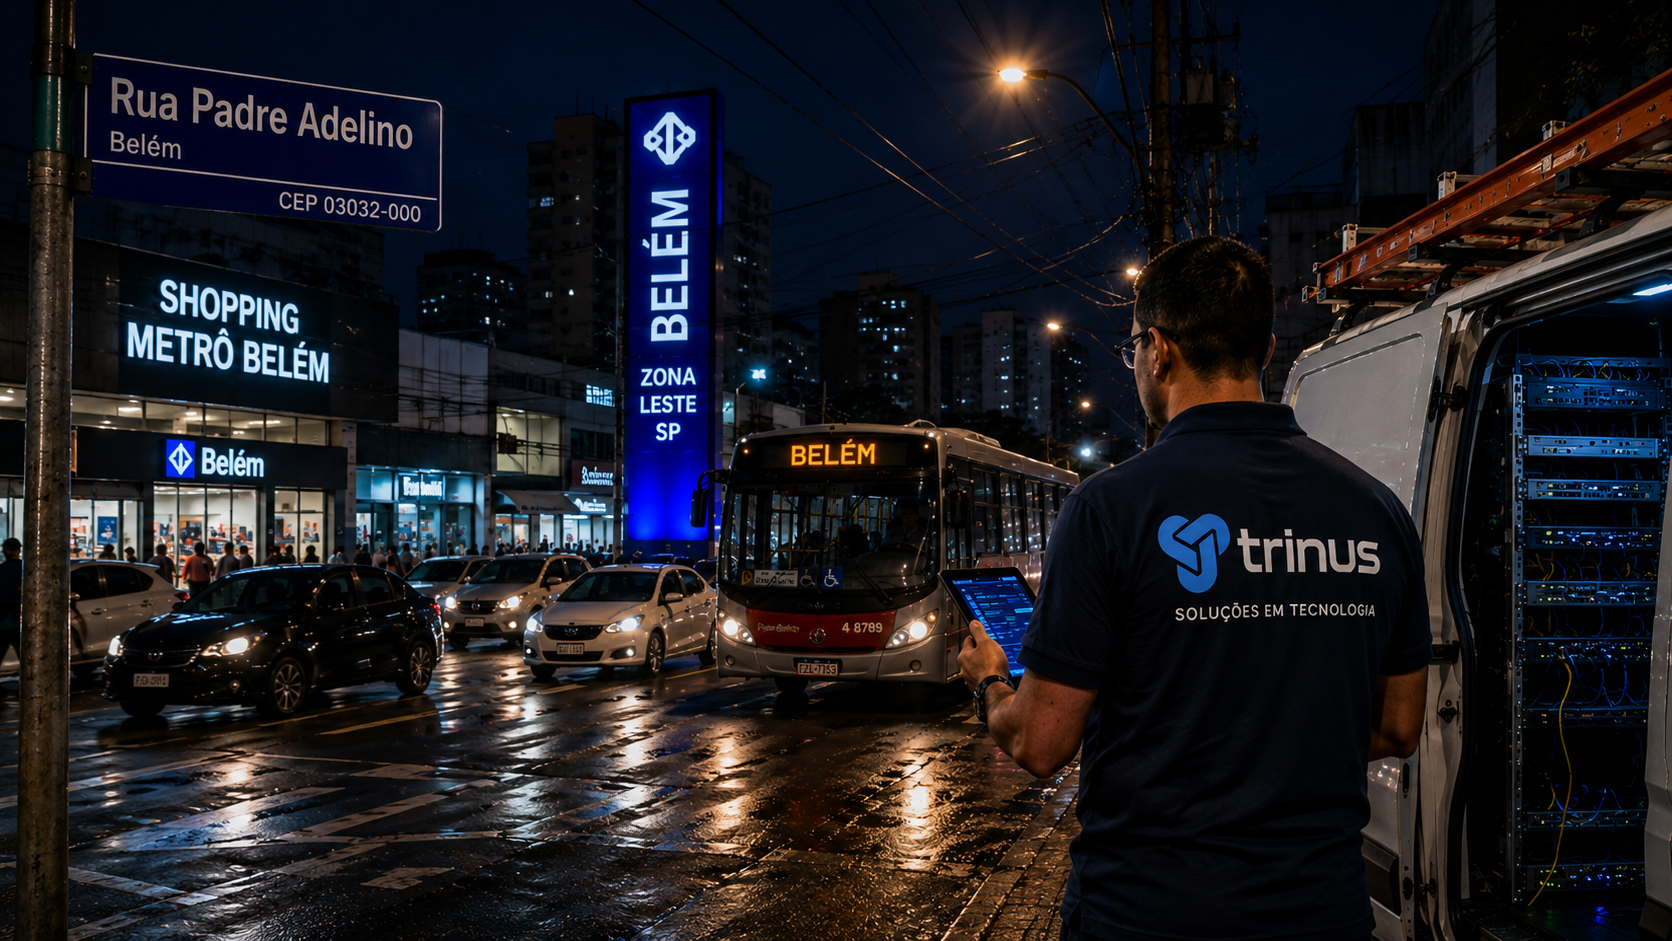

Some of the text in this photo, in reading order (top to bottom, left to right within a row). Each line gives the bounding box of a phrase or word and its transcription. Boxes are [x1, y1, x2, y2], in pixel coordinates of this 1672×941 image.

[111, 76, 413, 150] Rua Padre Adelino
[110, 131, 181, 160] Belém
[279, 191, 421, 223] CEP 03032-000
[643, 189, 689, 342] BELÉM
[159, 279, 299, 334] SHOPPING
[127, 322, 329, 384] METRÔ BELÉM
[640, 367, 697, 387] ZONA
[640, 394, 697, 413] LESTE
[655, 422, 681, 441] SP
[201, 447, 264, 477] Belém
[790, 439, 876, 466] BELÉM
[1237, 528, 1381, 575] trinus
[1175, 602, 1376, 622] SOLUÇÕES EM TECNOLOGIA
[842, 622, 883, 633] 4 8789
